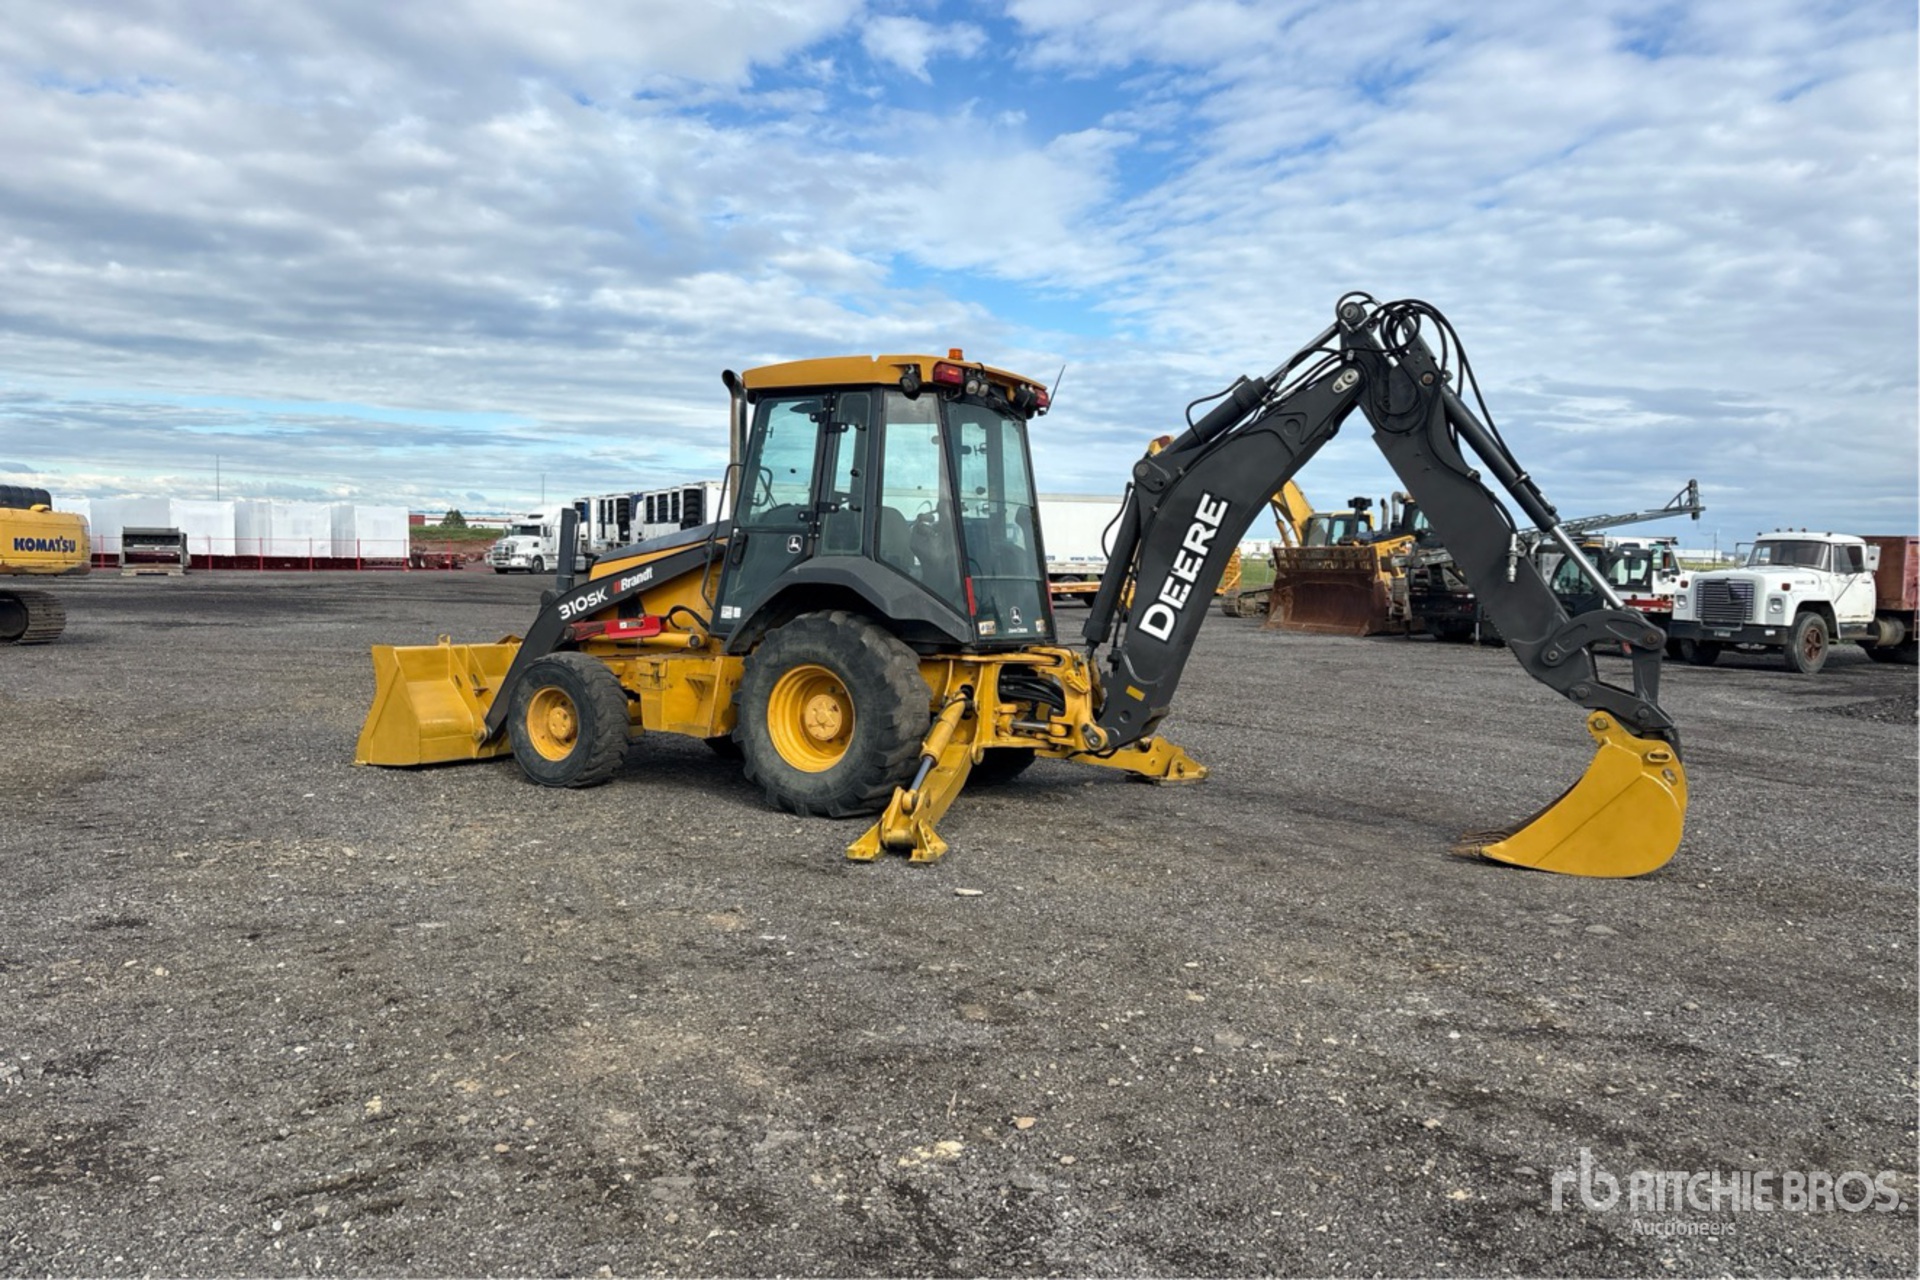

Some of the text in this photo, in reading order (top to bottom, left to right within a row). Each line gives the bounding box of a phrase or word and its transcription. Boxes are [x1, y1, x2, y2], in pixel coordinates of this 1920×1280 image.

[13, 535, 76, 553] KOMATSU
[620, 566, 653, 592] Brandt
[1138, 493, 1229, 642] DEERE
[558, 586, 609, 620] 310SK
